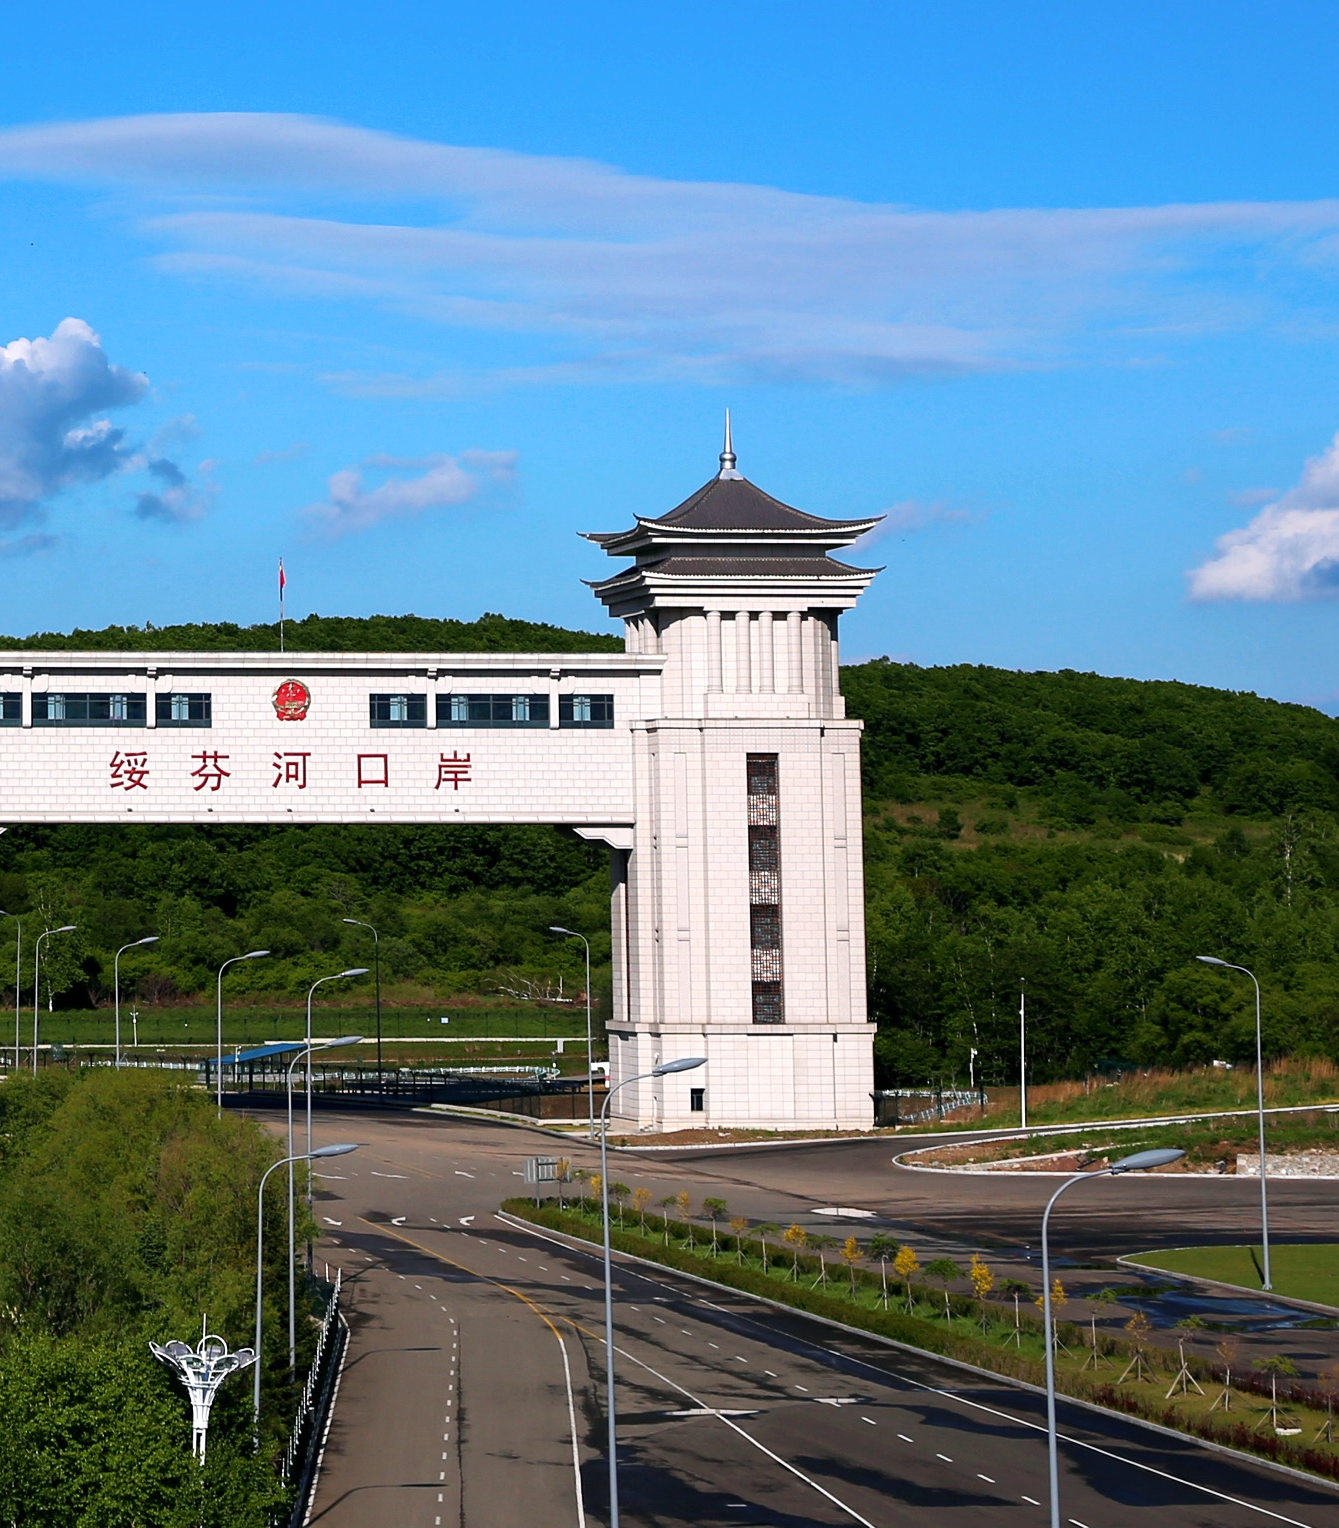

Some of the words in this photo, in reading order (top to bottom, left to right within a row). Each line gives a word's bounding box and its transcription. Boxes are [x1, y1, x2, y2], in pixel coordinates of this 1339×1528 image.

[108, 749, 472, 791] 绥芬河口岸
